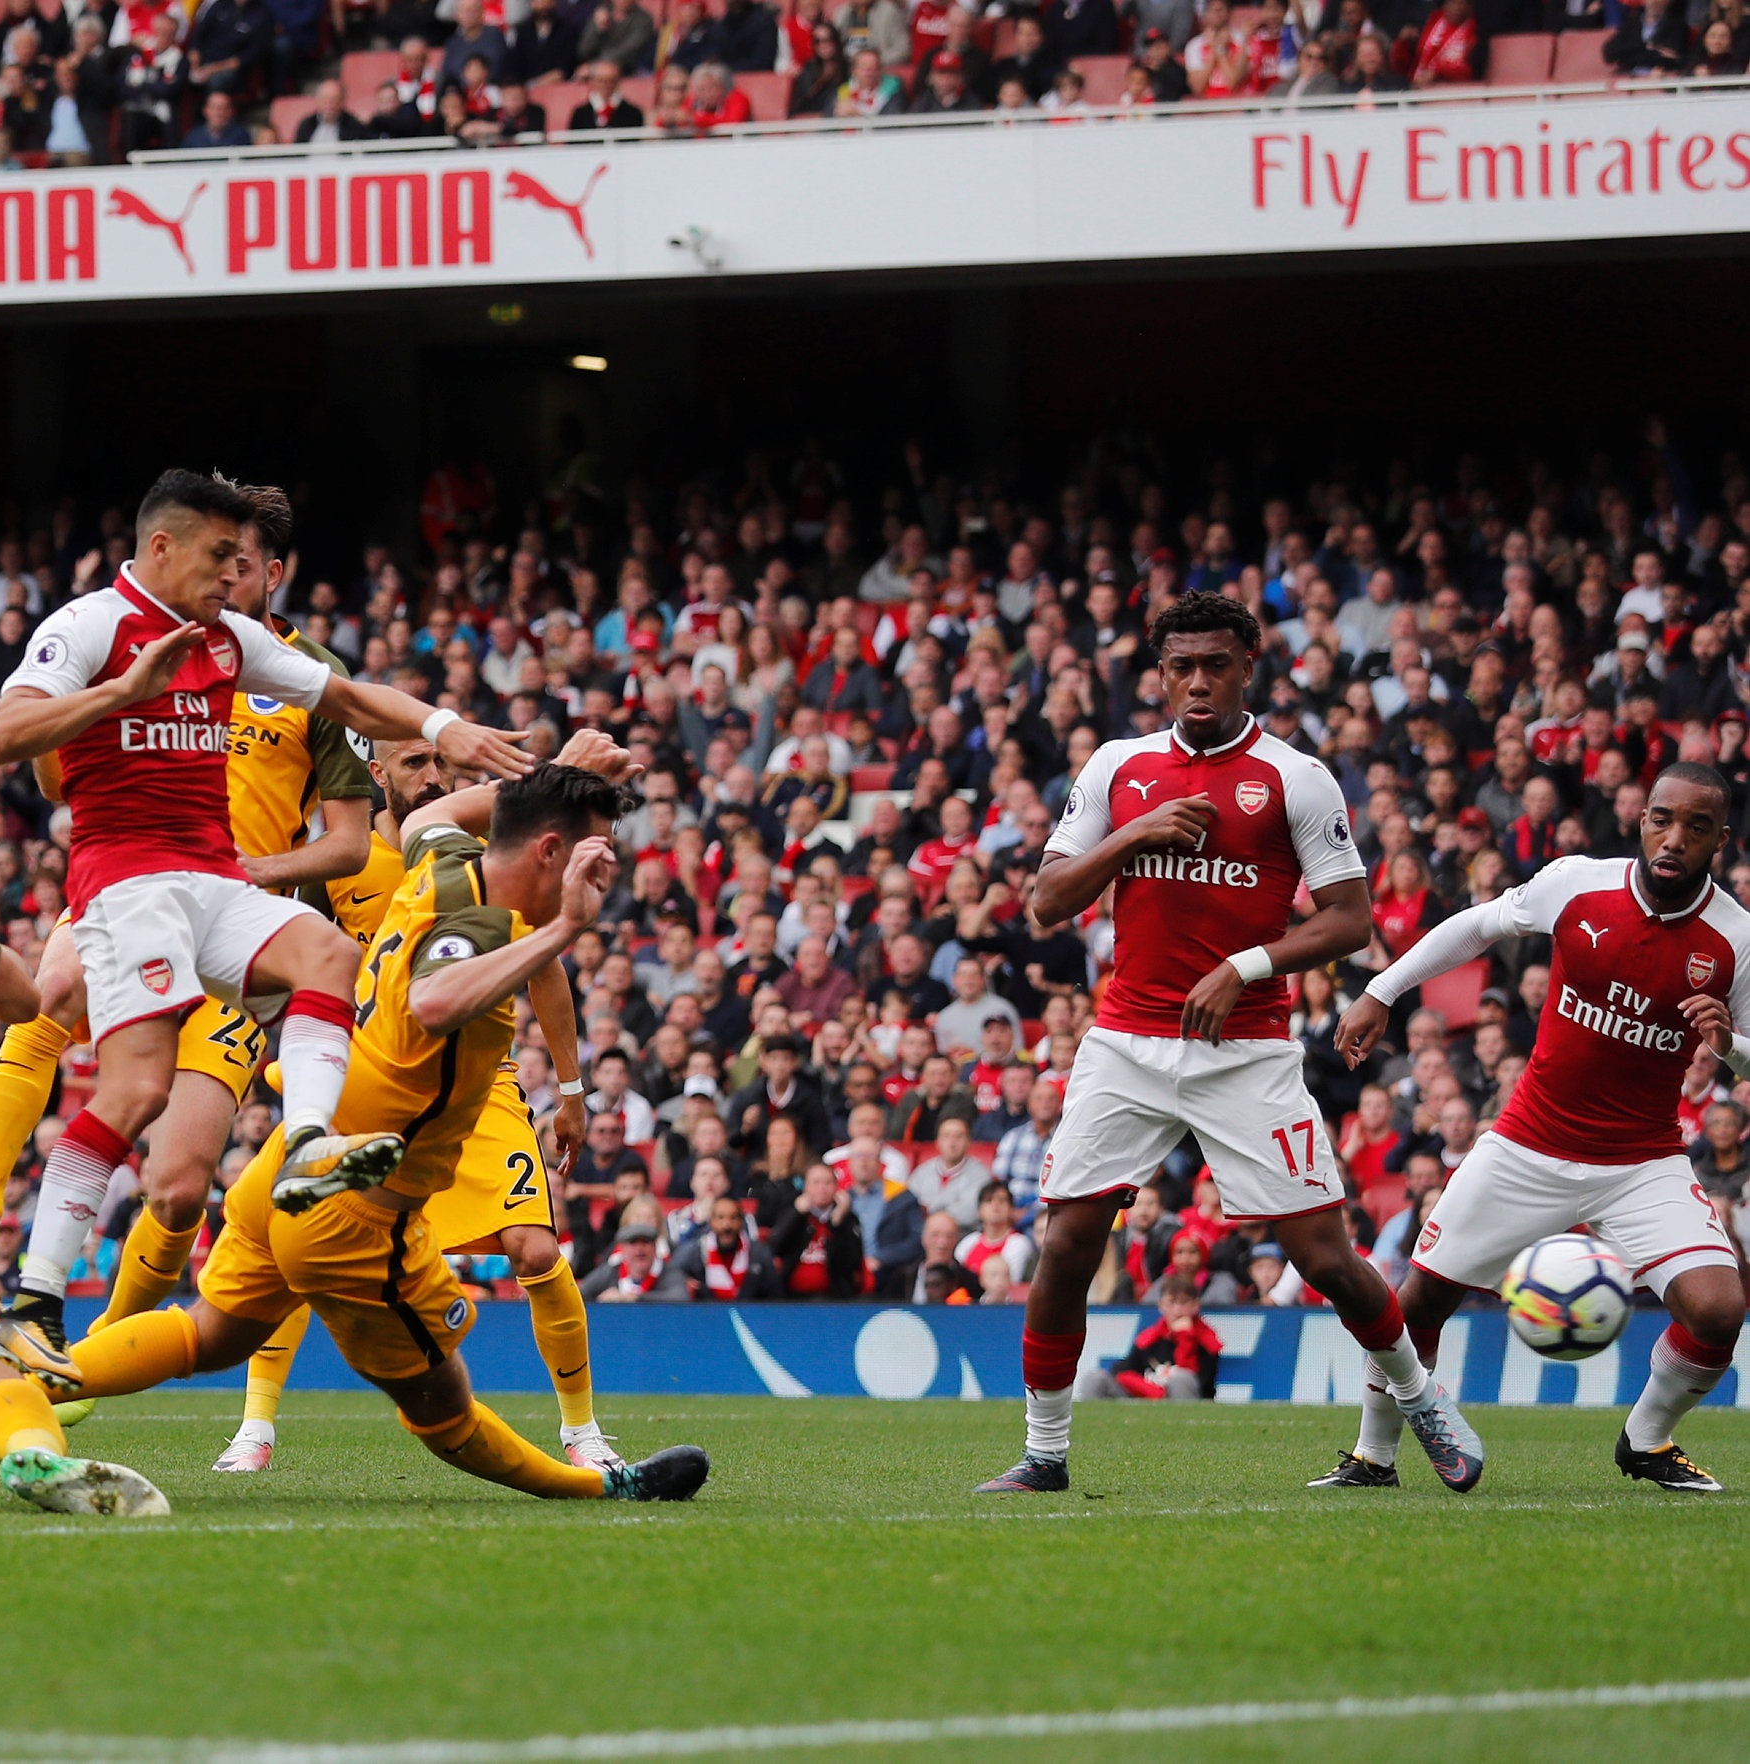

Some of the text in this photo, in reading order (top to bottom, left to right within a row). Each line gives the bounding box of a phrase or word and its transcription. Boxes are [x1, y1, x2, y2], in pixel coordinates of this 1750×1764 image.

[1252, 120, 1750, 229] Fly Emirates
[226, 169, 493, 276] PUMA
[173, 692, 210, 719] Fly
[1556, 983, 1686, 1053] Emirates
[1606, 980, 1652, 1016] Fly
[505, 1151, 538, 1197] 2
[1271, 1118, 1314, 1178] 17
